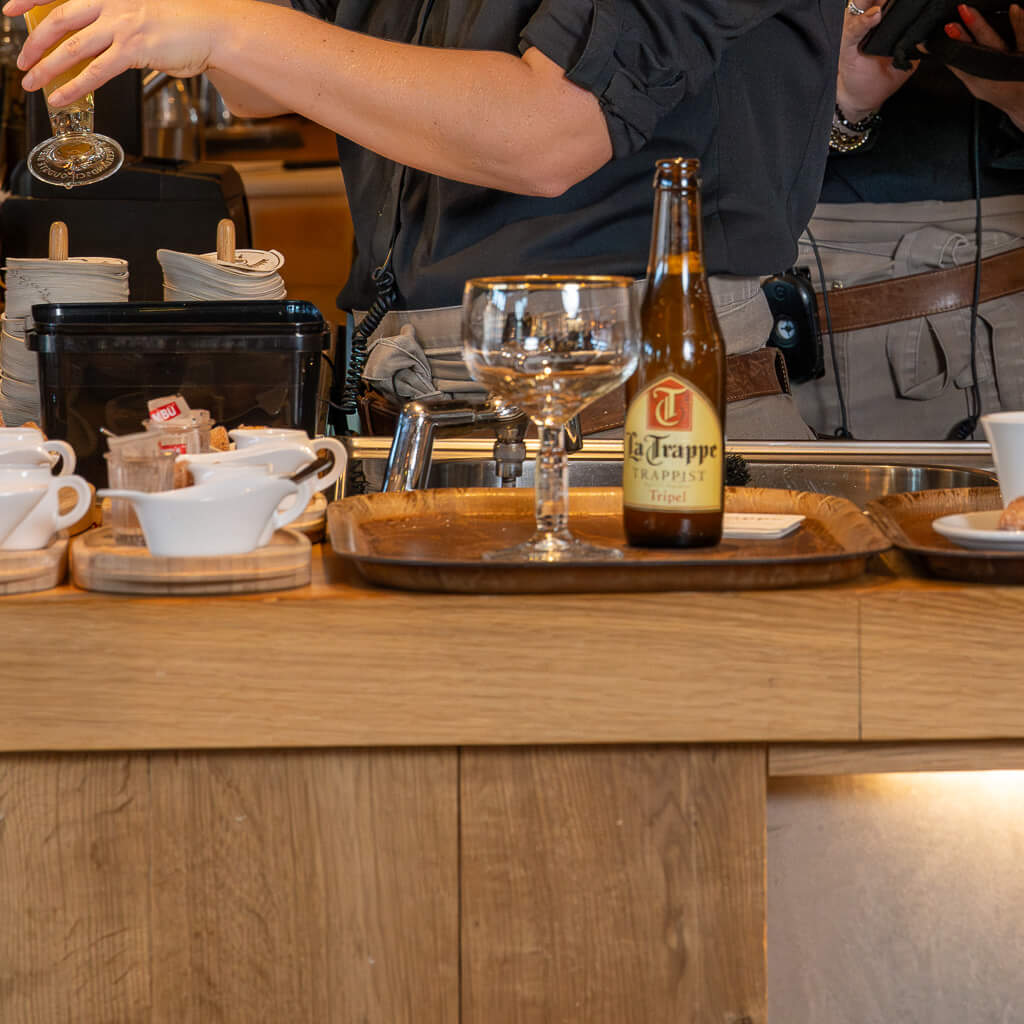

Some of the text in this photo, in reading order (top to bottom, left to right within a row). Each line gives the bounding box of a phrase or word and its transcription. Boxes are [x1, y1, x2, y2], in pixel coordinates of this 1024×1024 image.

[626, 431, 718, 466] La Trappe
[632, 467, 706, 483] TRAPPIST
[649, 489, 687, 504] Tripel
